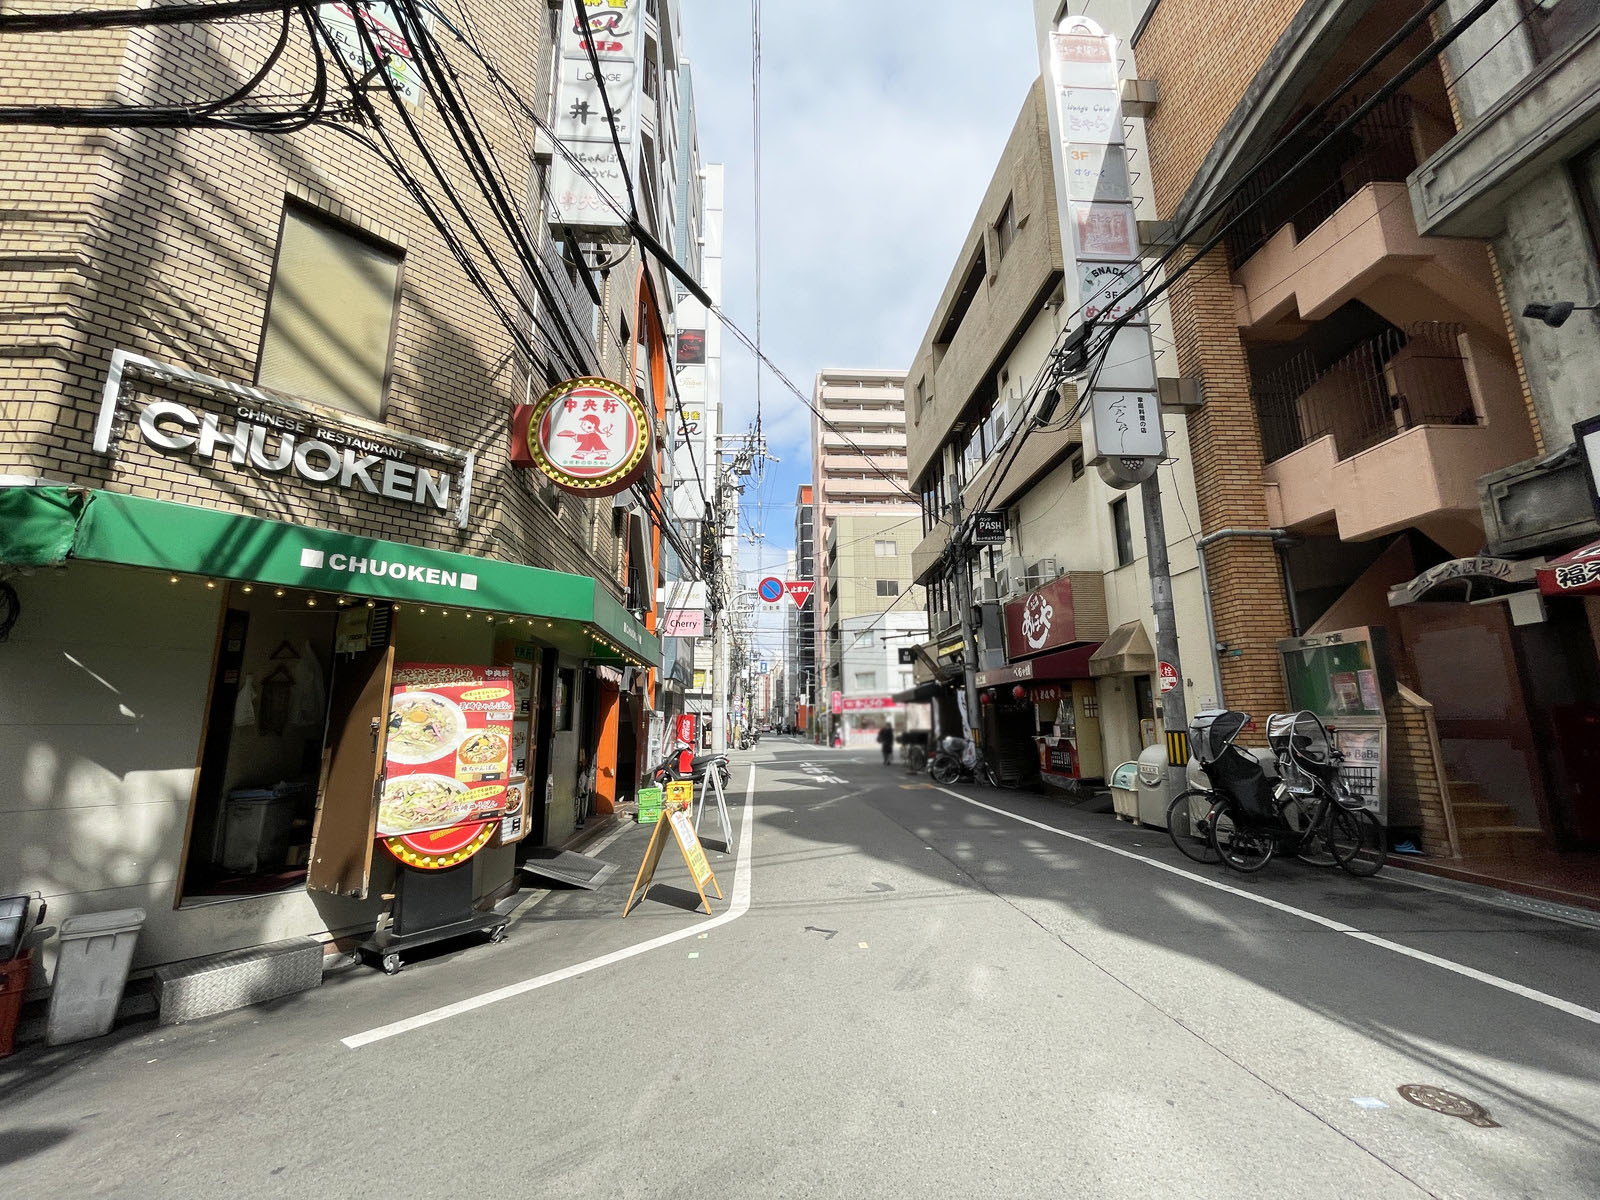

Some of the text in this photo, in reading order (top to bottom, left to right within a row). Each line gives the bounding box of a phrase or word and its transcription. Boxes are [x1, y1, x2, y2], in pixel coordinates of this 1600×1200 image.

[327, 24, 350, 47] TEL
[1071, 151, 1090, 161] 3F
[564, 398, 620, 414] 中央軒
[236, 405, 407, 460] CHINESE RESTAURANT
[138, 401, 451, 510] CHUOKEN
[979, 521, 1002, 530] PASH
[329, 553, 458, 588] CHUOKEN
[790, 585, 810, 594] 止まれ
[670, 619, 698, 629] Cherry
